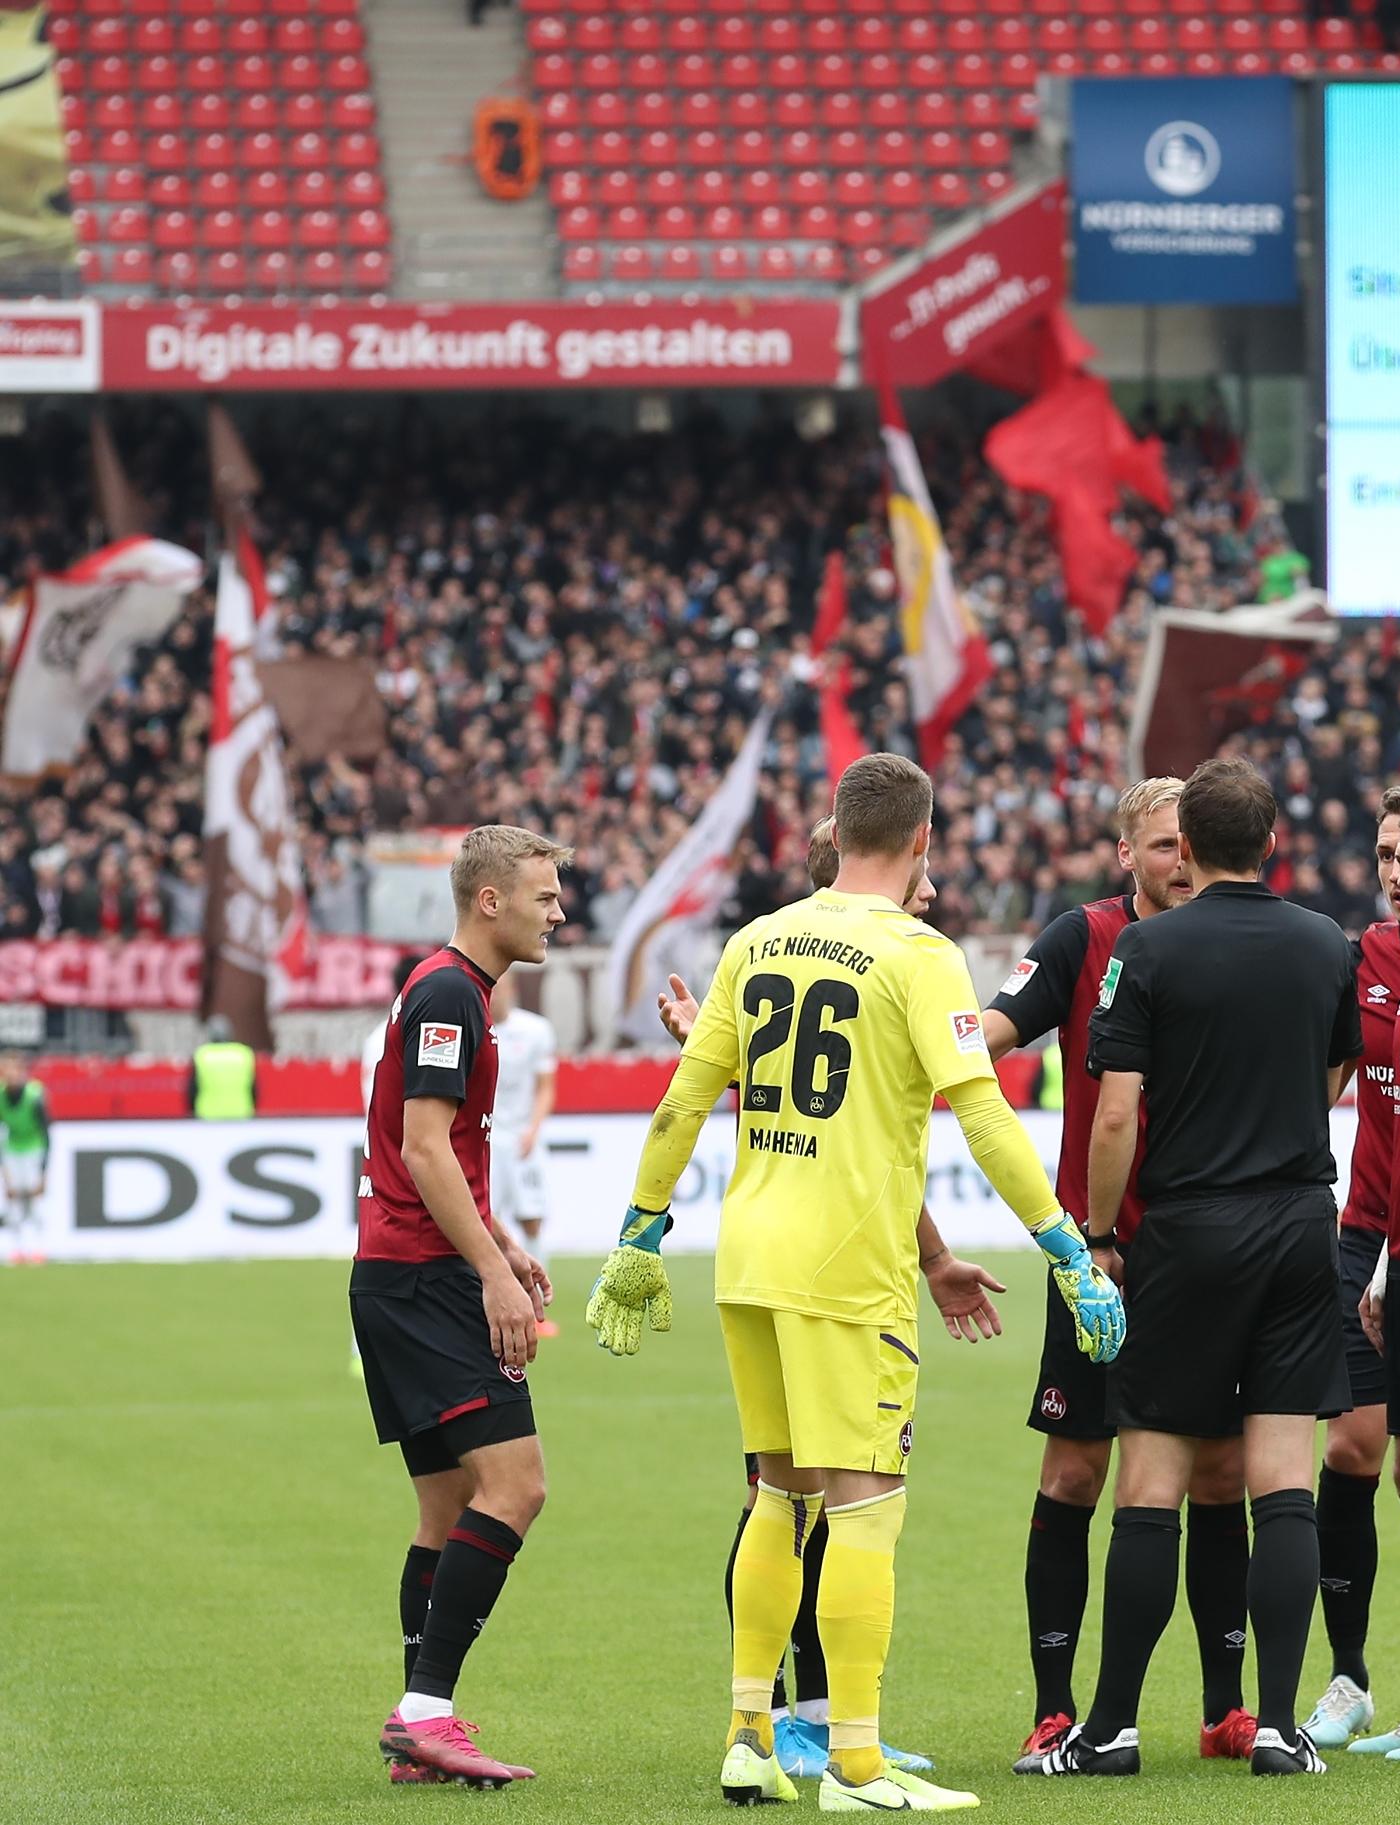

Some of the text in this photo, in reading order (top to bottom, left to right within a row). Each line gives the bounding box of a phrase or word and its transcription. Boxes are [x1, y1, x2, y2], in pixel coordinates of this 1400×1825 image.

[1081, 201, 1284, 234] NÜRNBERGER
[147, 321, 343, 383] Digitale
[348, 319, 549, 370] Zukunft
[556, 318, 793, 380] gestalten
[749, 931, 875, 976] 1. FC NÜRNBERG
[742, 973, 860, 1120] 26
